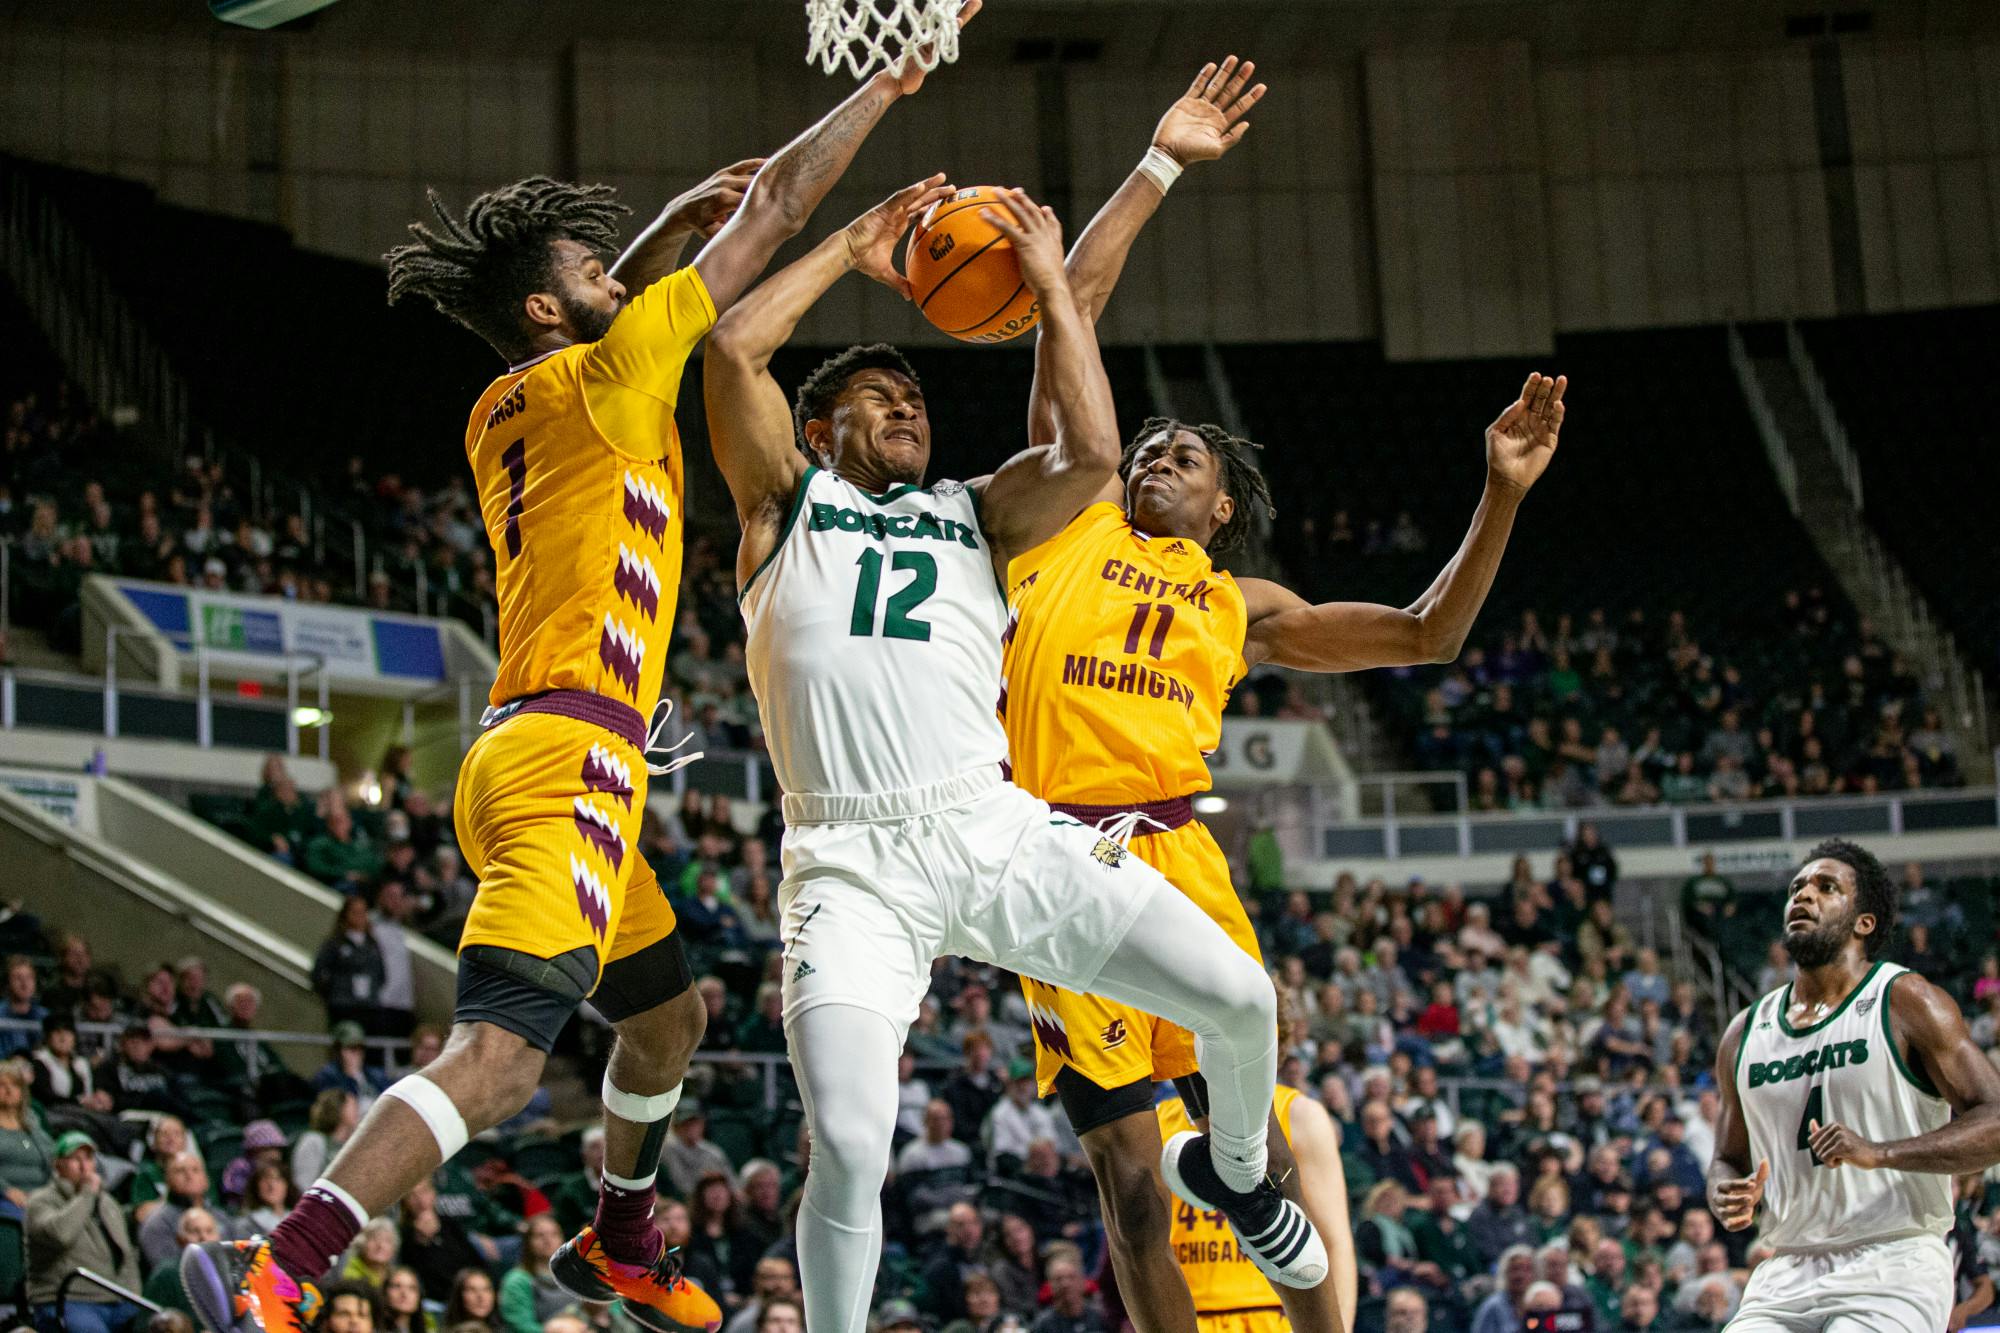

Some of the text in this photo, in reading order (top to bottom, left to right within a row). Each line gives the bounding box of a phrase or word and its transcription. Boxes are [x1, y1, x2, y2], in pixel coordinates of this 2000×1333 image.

[501, 437, 527, 561] 1
[850, 547, 938, 642] 12
[1101, 558, 1214, 612] CENTRAL
[1124, 602, 1175, 661] 11
[1062, 654, 1195, 713] MICHIGAN
[1749, 1039, 1869, 1089] BOBCATS
[1178, 1201, 1227, 1231] 44
